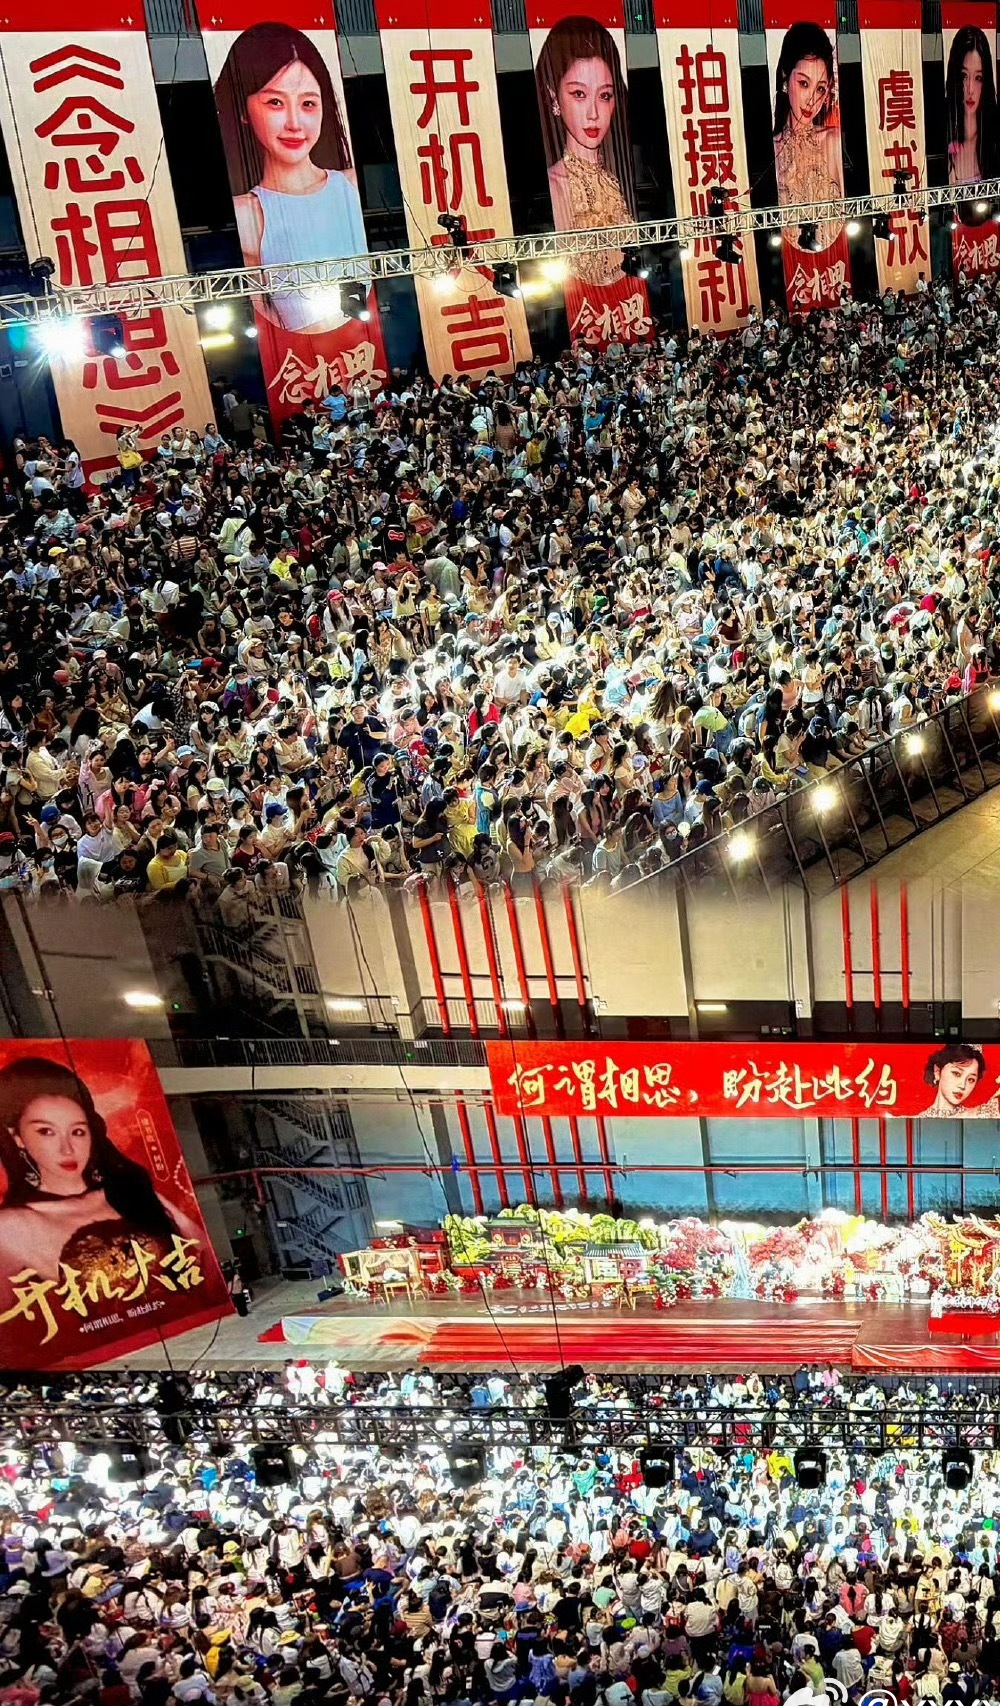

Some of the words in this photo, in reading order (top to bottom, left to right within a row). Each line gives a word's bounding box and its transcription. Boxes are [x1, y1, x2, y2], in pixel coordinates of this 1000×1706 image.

[953, 234, 1000, 271] 念相思
[786, 261, 852, 302] 念相思
[570, 292, 653, 345] 念相思
